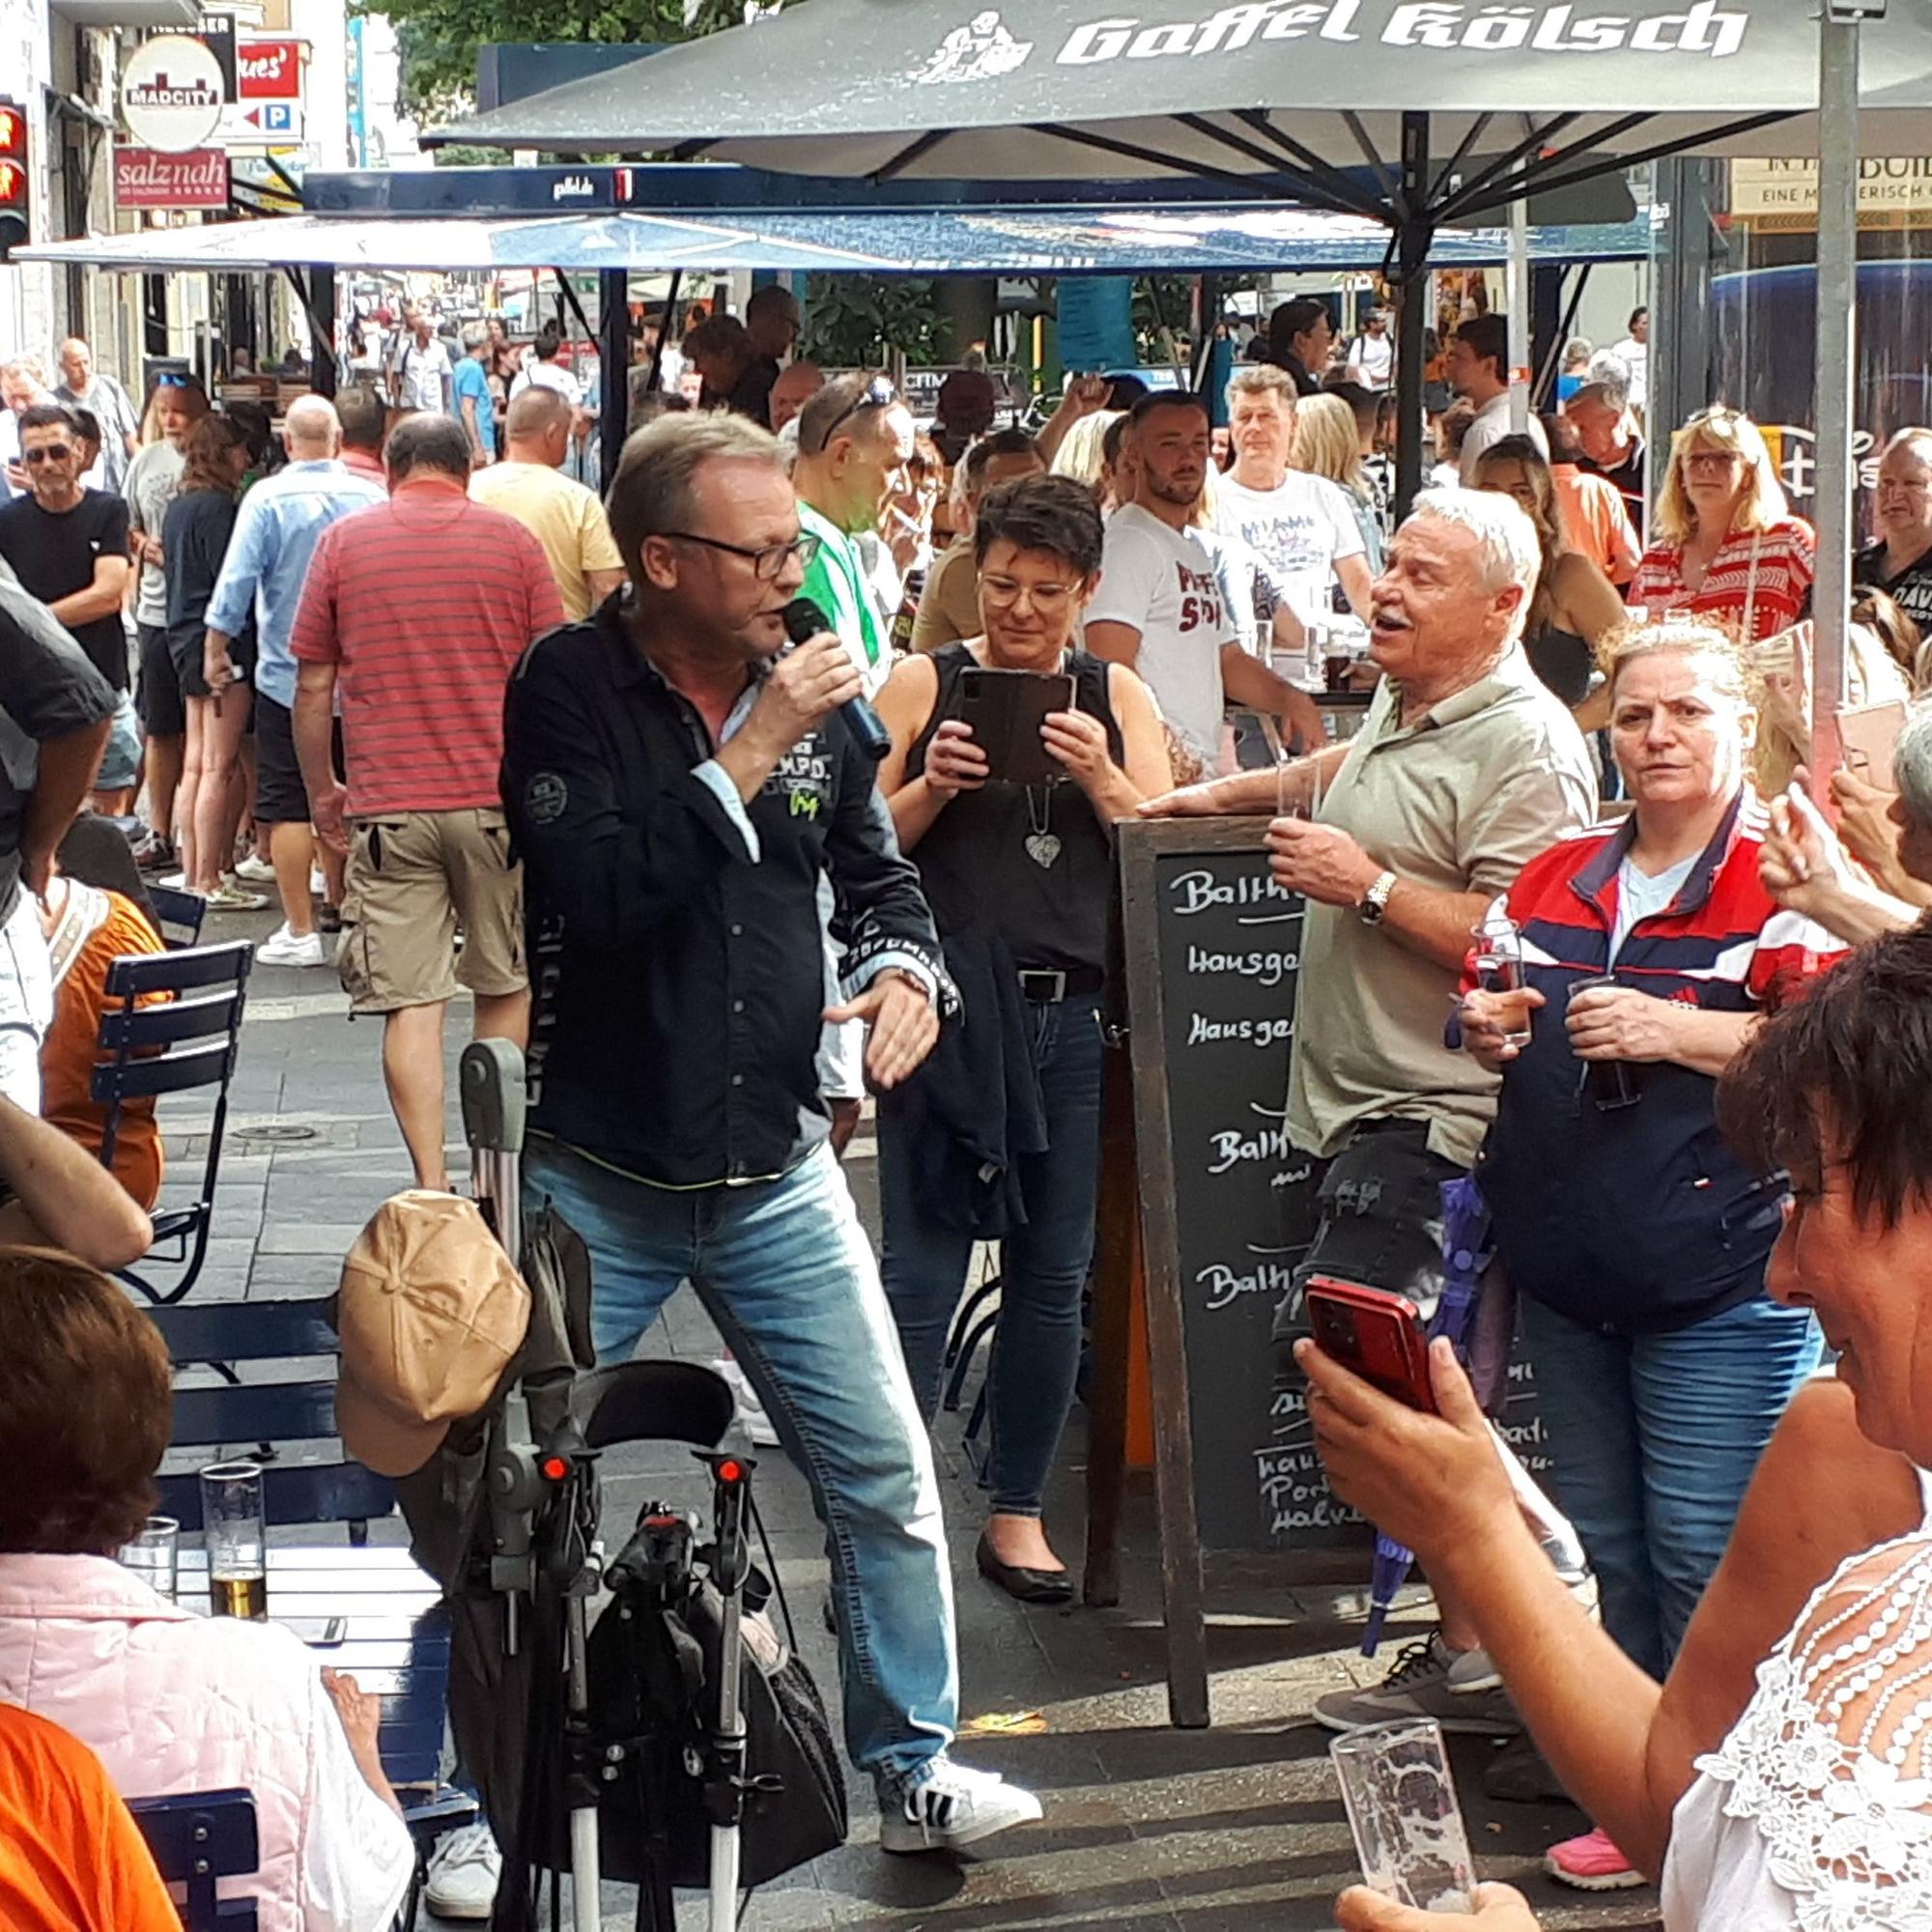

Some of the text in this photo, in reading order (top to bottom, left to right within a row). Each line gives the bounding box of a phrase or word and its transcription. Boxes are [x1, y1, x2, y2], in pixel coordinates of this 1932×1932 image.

[1055, 0, 1749, 65] Gaffel Kölsch
[270, 106, 286, 128] P
[1763, 187, 1798, 202] EINE
[1170, 870, 1305, 914] Balth
